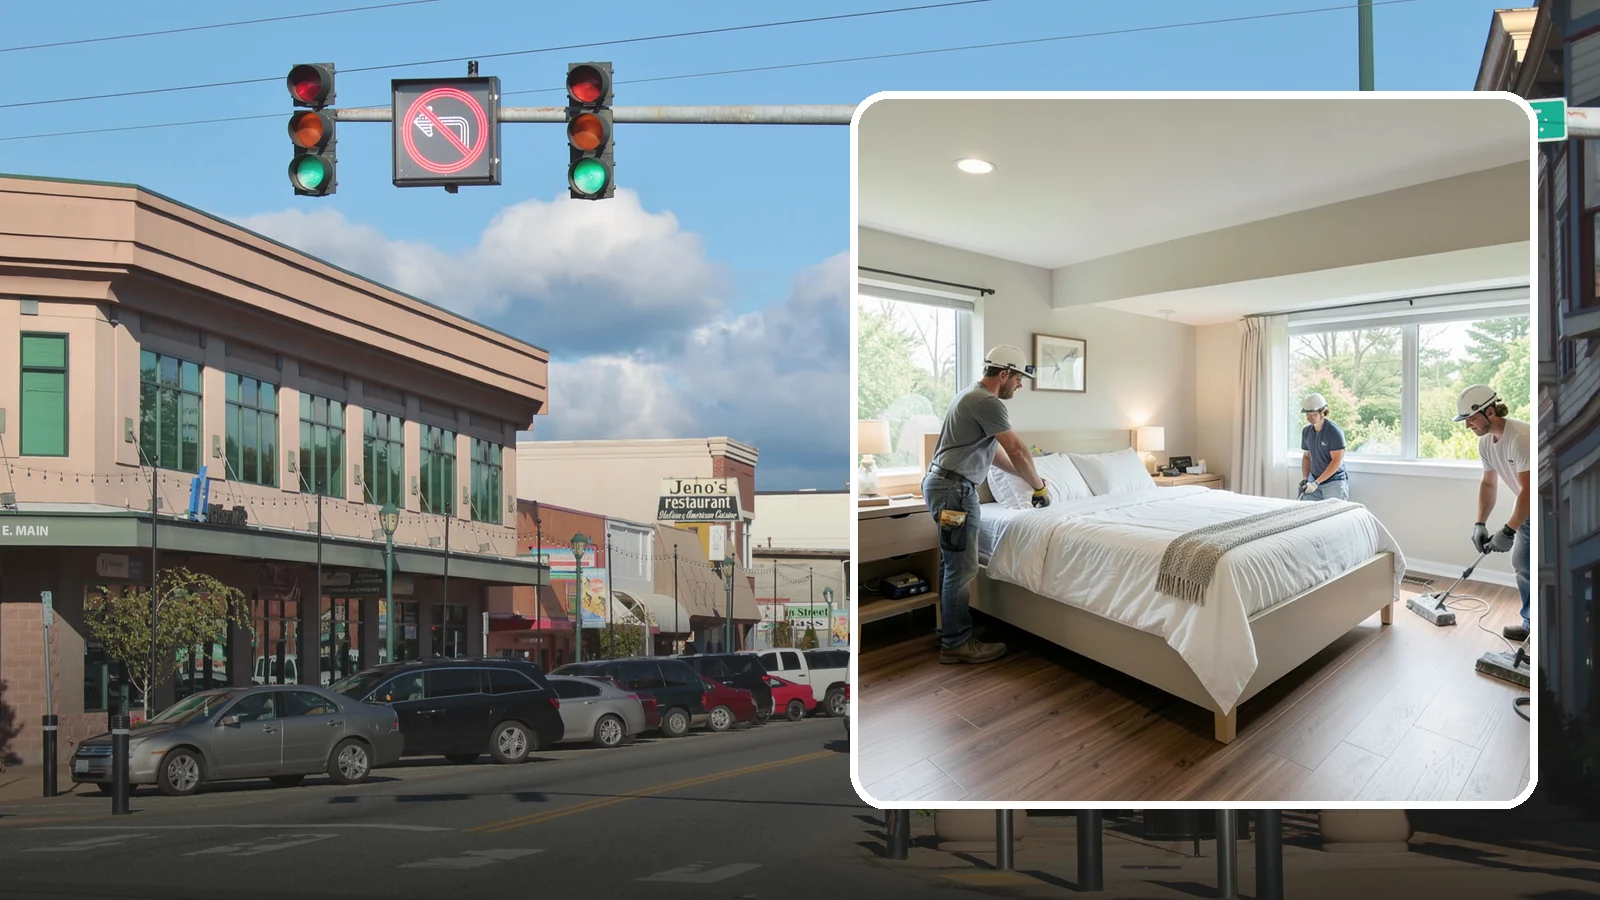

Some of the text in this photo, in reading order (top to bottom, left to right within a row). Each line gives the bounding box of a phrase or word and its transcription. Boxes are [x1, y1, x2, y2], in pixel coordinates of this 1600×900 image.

[670, 480, 728, 494] Jeno's
[665, 496, 730, 508] restaurant
[658, 510, 682, 519] Italian
[686, 510, 714, 519] American
[715, 509, 738, 519] Cuisine
[2, 525, 48, 536] E. MAIN
[785, 607, 795, 617] in
[797, 607, 828, 617] Street
[790, 619, 824, 627] lass
